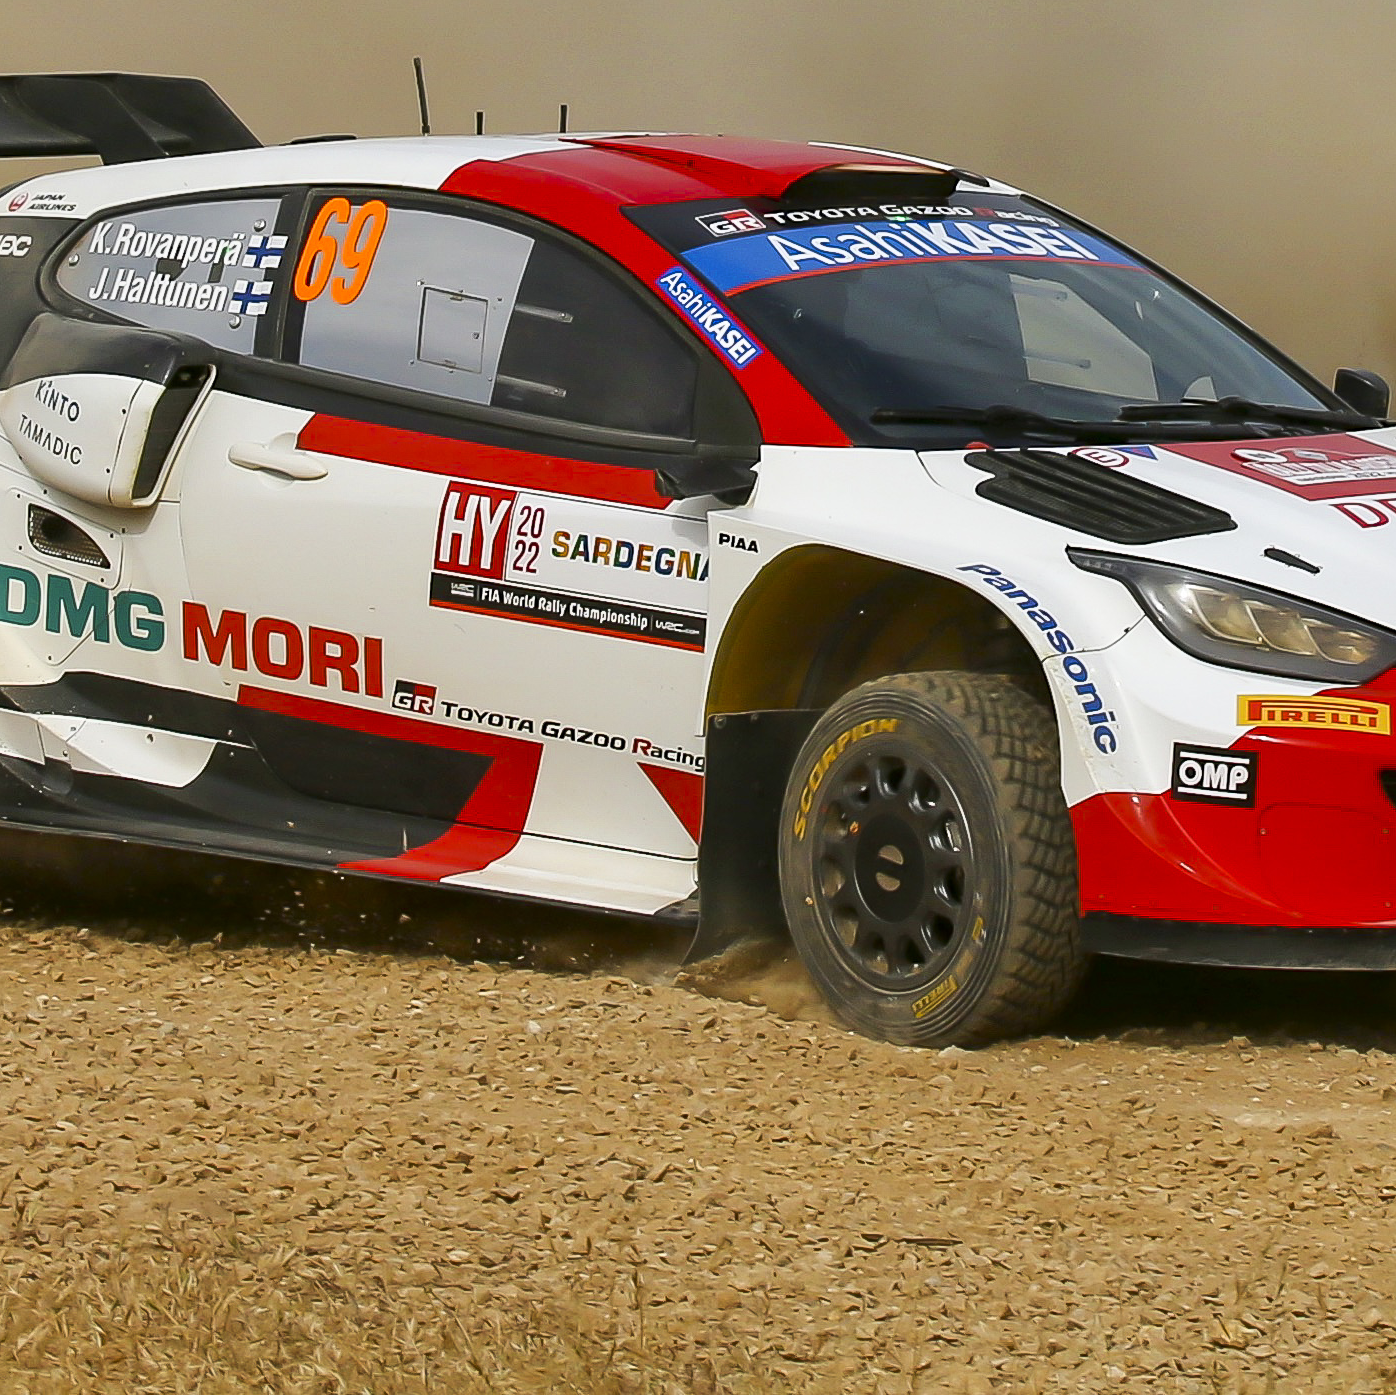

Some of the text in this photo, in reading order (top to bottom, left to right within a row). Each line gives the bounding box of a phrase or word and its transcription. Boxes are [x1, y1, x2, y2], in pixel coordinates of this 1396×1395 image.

[27, 203, 77, 212] AIRLINES
[709, 216, 758, 235] GR
[764, 206, 879, 224] TOYOTA
[879, 204, 974, 216] GAZOO
[294, 197, 389, 305] 69
[767, 221, 1100, 271] AsahiKASEI
[660, 271, 757, 364] AsahiKASEI
[19, 414, 83, 465] TAMADIC
[439, 491, 511, 570] HY
[517, 506, 545, 538] 20
[718, 532, 759, 554] PIAA
[512, 540, 540, 573] 22
[481, 587, 500, 603] FIA
[503, 591, 535, 609] World
[538, 597, 566, 617] Rally
[569, 602, 648, 631] Championship
[182, 600, 384, 699] MORI
[441, 700, 535, 735] TOYOTA
[540, 720, 627, 752] GAZOO
[631, 737, 705, 772] Racing
[1248, 700, 1380, 728] PIRELLI
[1178, 759, 1249, 791] OMP
